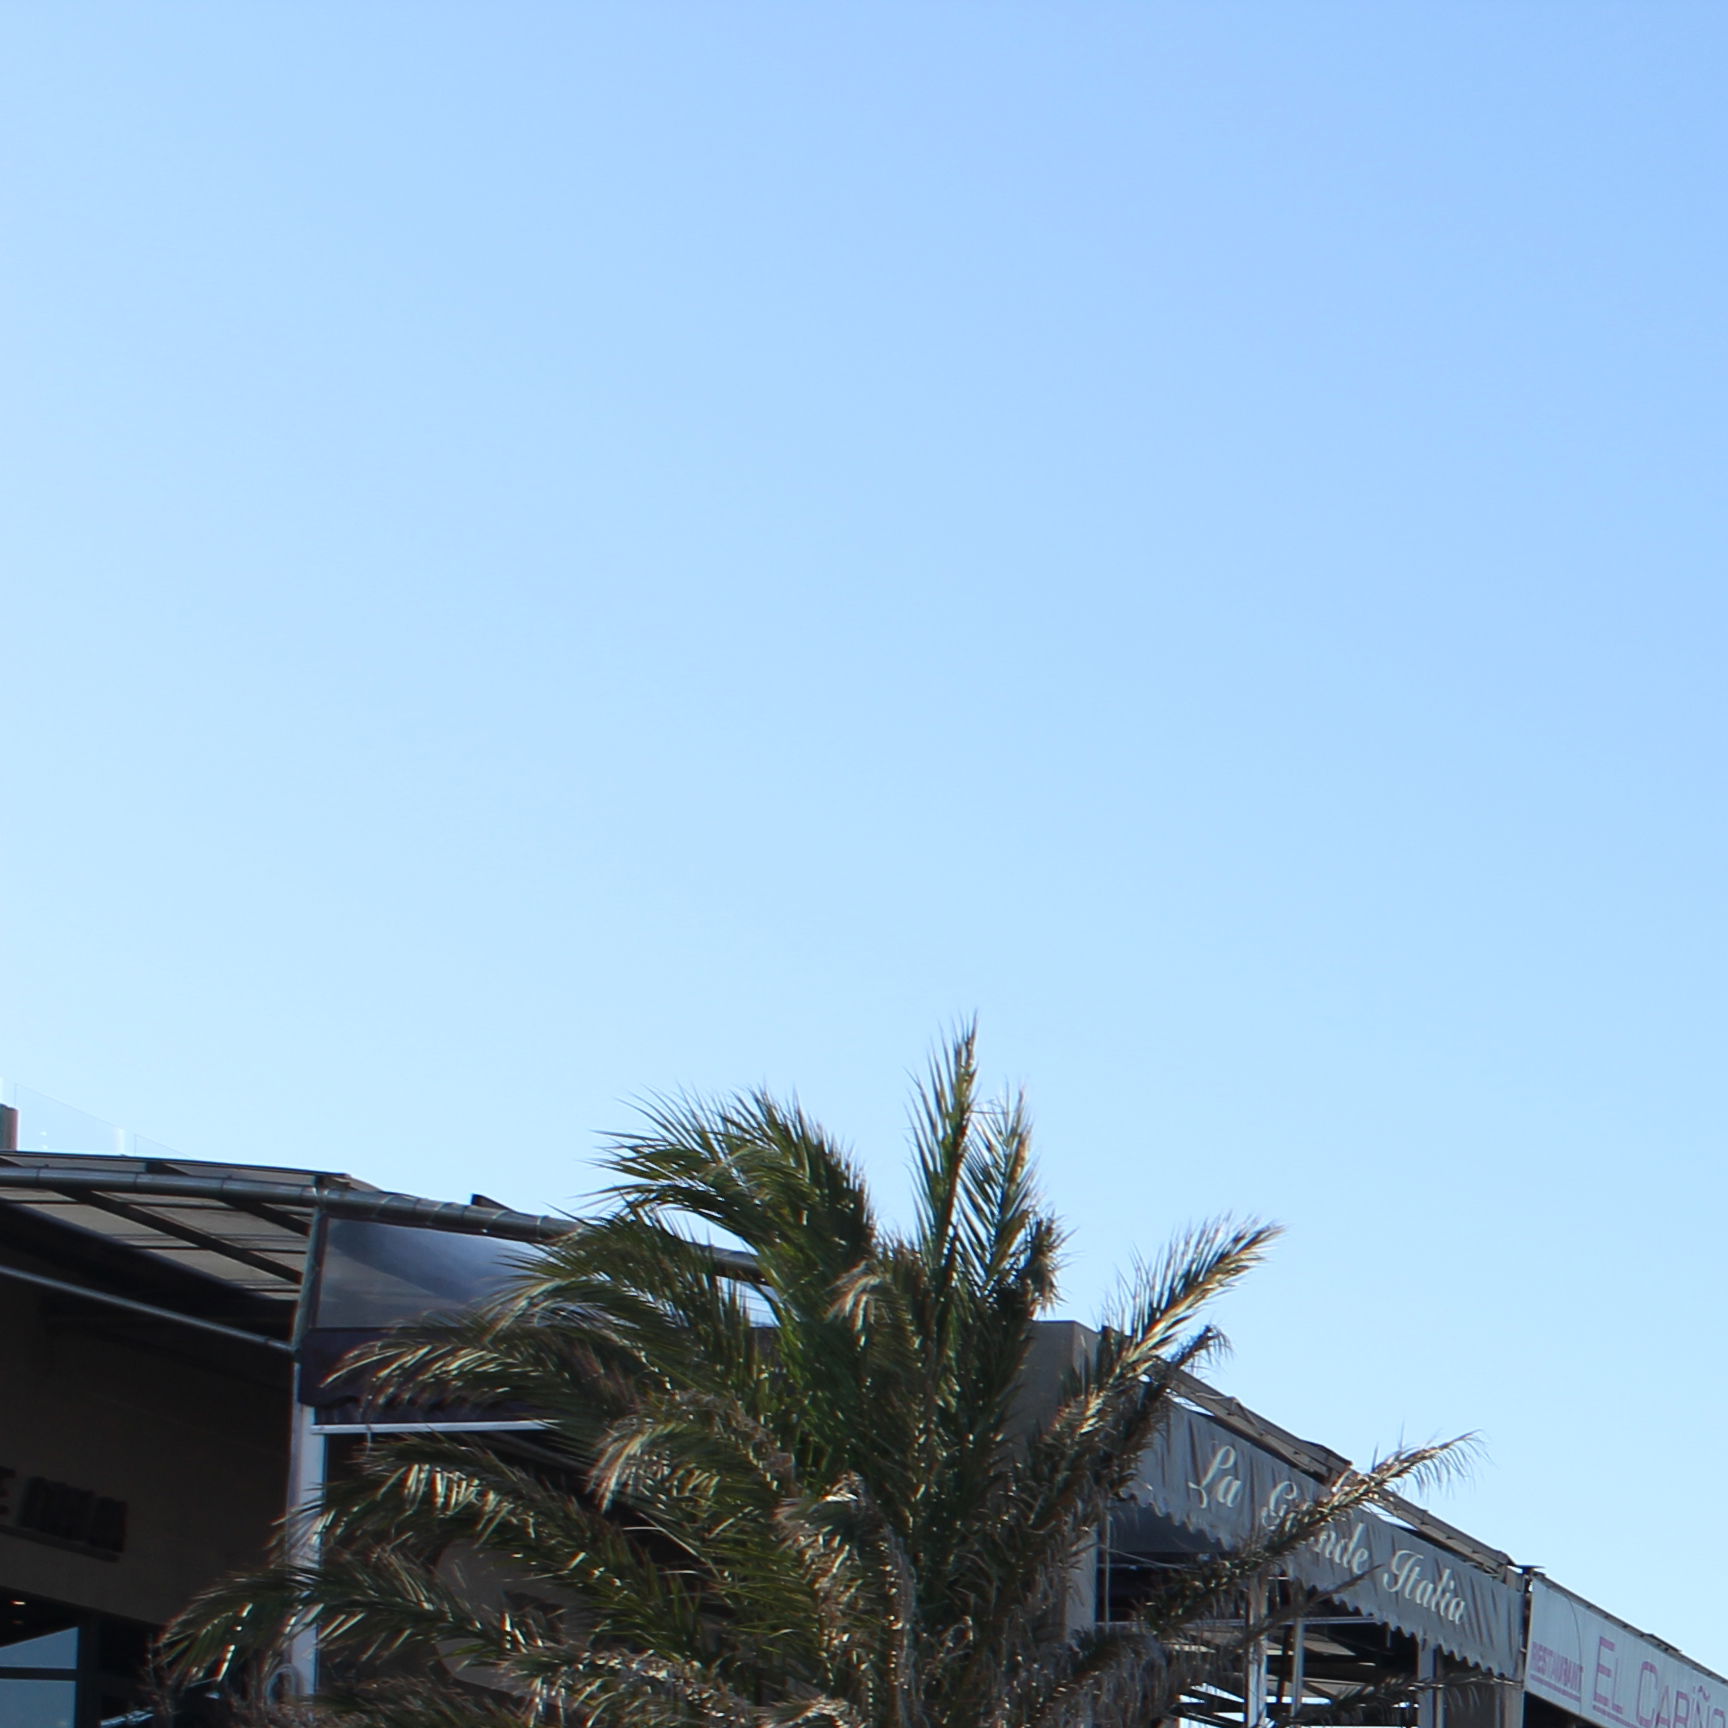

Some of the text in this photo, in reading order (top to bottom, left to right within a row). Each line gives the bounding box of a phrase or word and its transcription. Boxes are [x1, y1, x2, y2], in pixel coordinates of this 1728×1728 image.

[1188, 1444, 1468, 1626] La Grnde Italia
